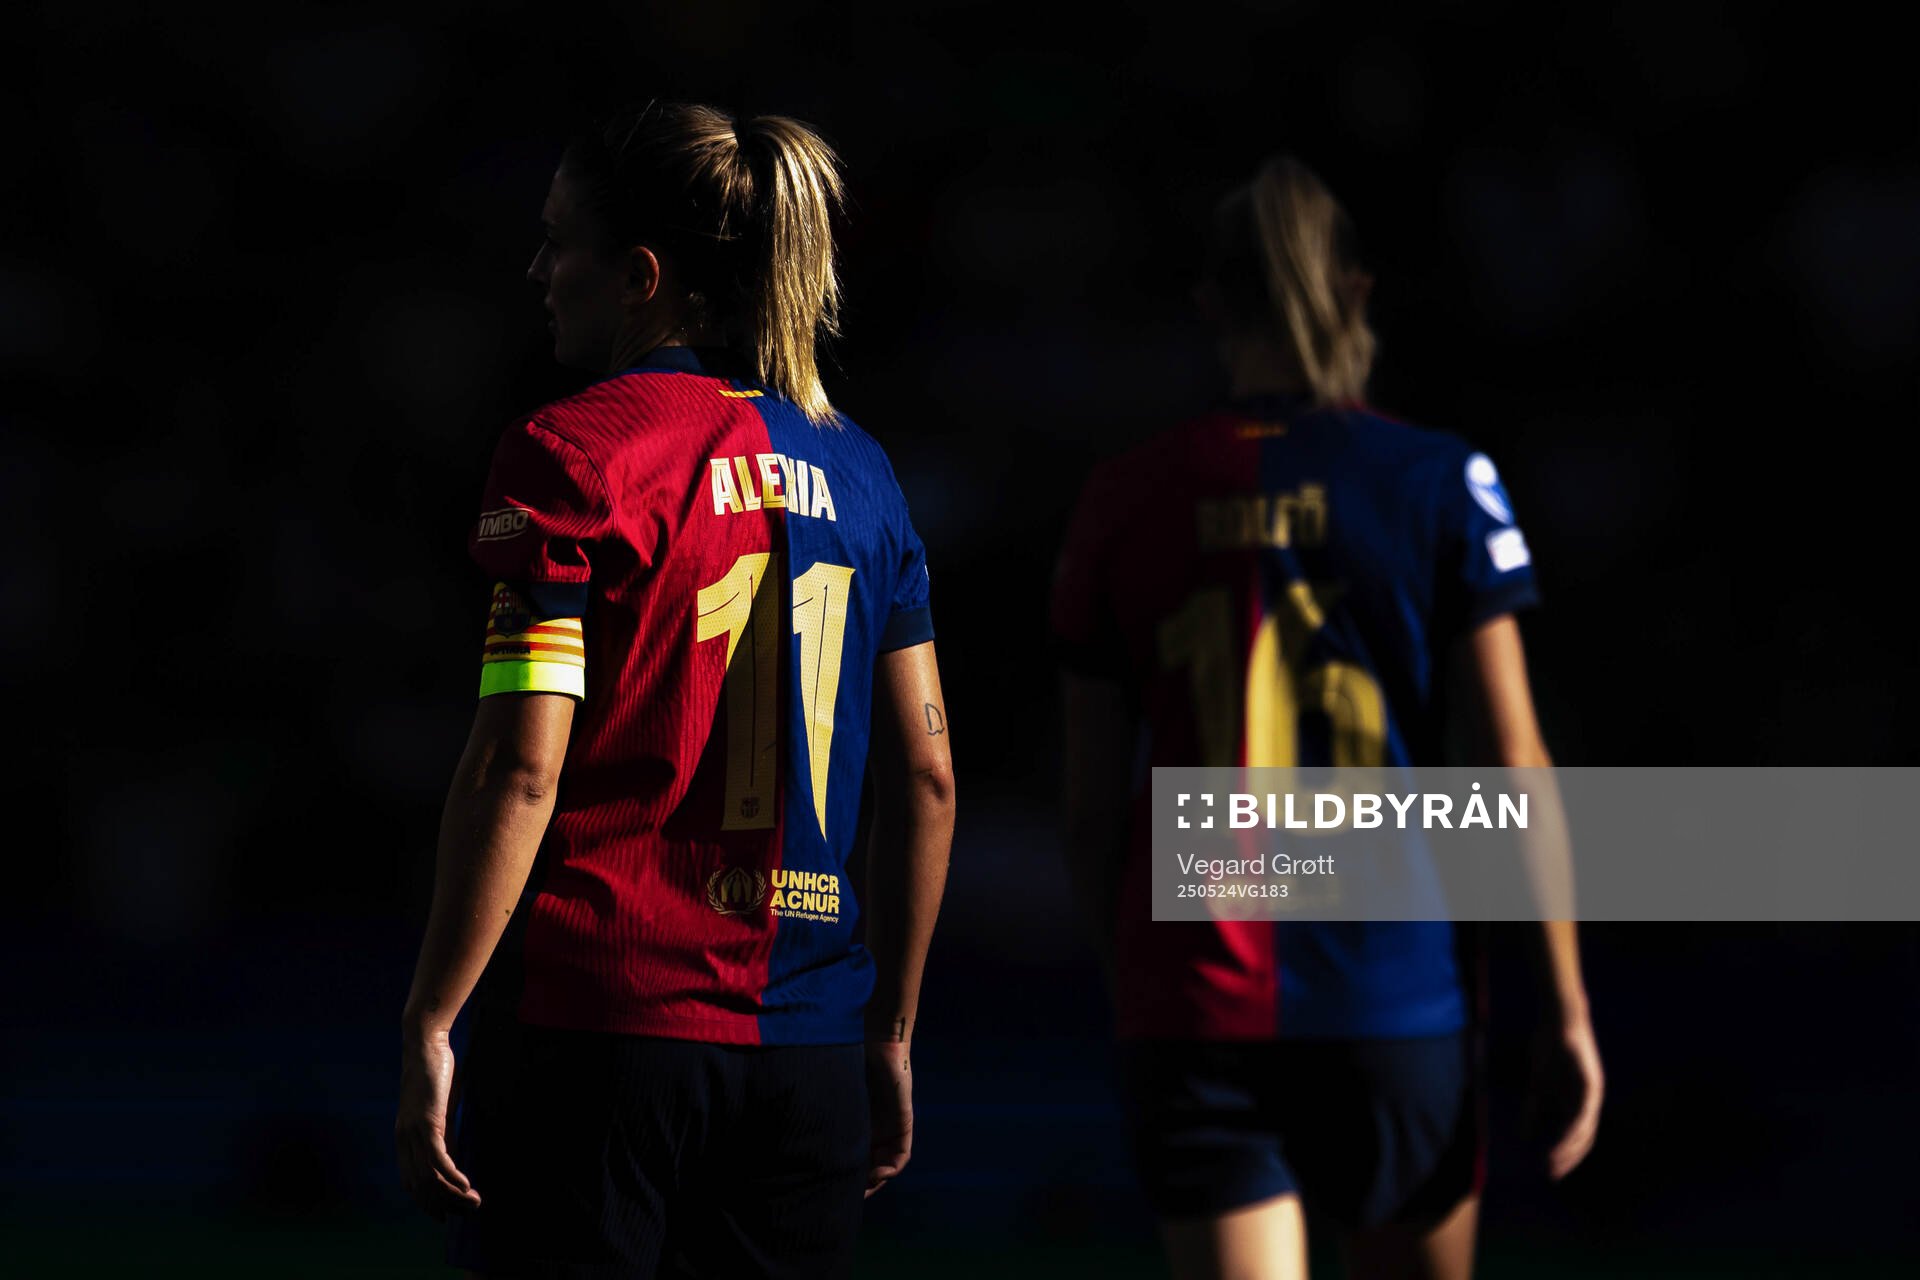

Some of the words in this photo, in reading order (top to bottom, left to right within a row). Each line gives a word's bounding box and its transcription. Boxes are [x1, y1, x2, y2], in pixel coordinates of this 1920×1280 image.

[709, 453, 837, 522] ALEXIA
[479, 511, 529, 537] IMBO
[697, 552, 856, 843] 11
[771, 869, 839, 894] UNHCR
[770, 889, 840, 914] ACNUR
[770, 908, 784, 917] The
[784, 910, 795, 918] UN
[796, 911, 819, 922] Refugee
[819, 914, 839, 924] Agency
